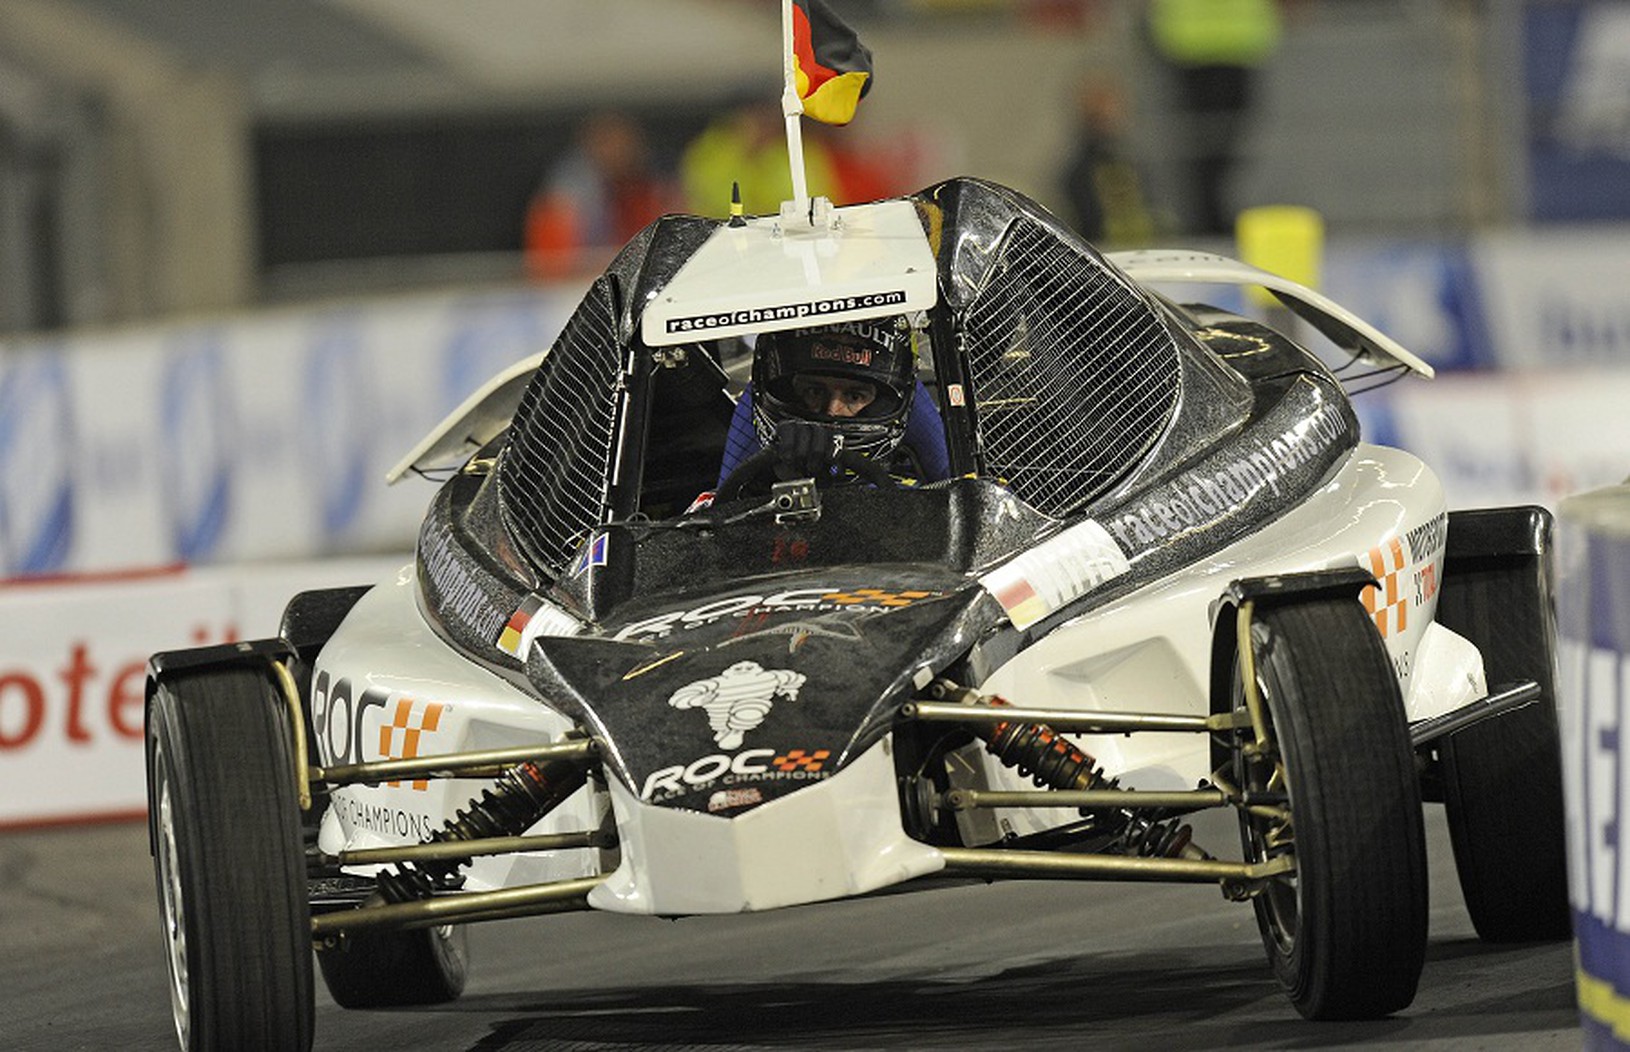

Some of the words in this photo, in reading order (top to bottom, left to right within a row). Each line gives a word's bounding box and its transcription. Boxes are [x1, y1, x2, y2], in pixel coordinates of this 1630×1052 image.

[669, 290, 903, 332] raceofchampions.com
[611, 588, 841, 641] ROC
[640, 749, 775, 802] ROC
